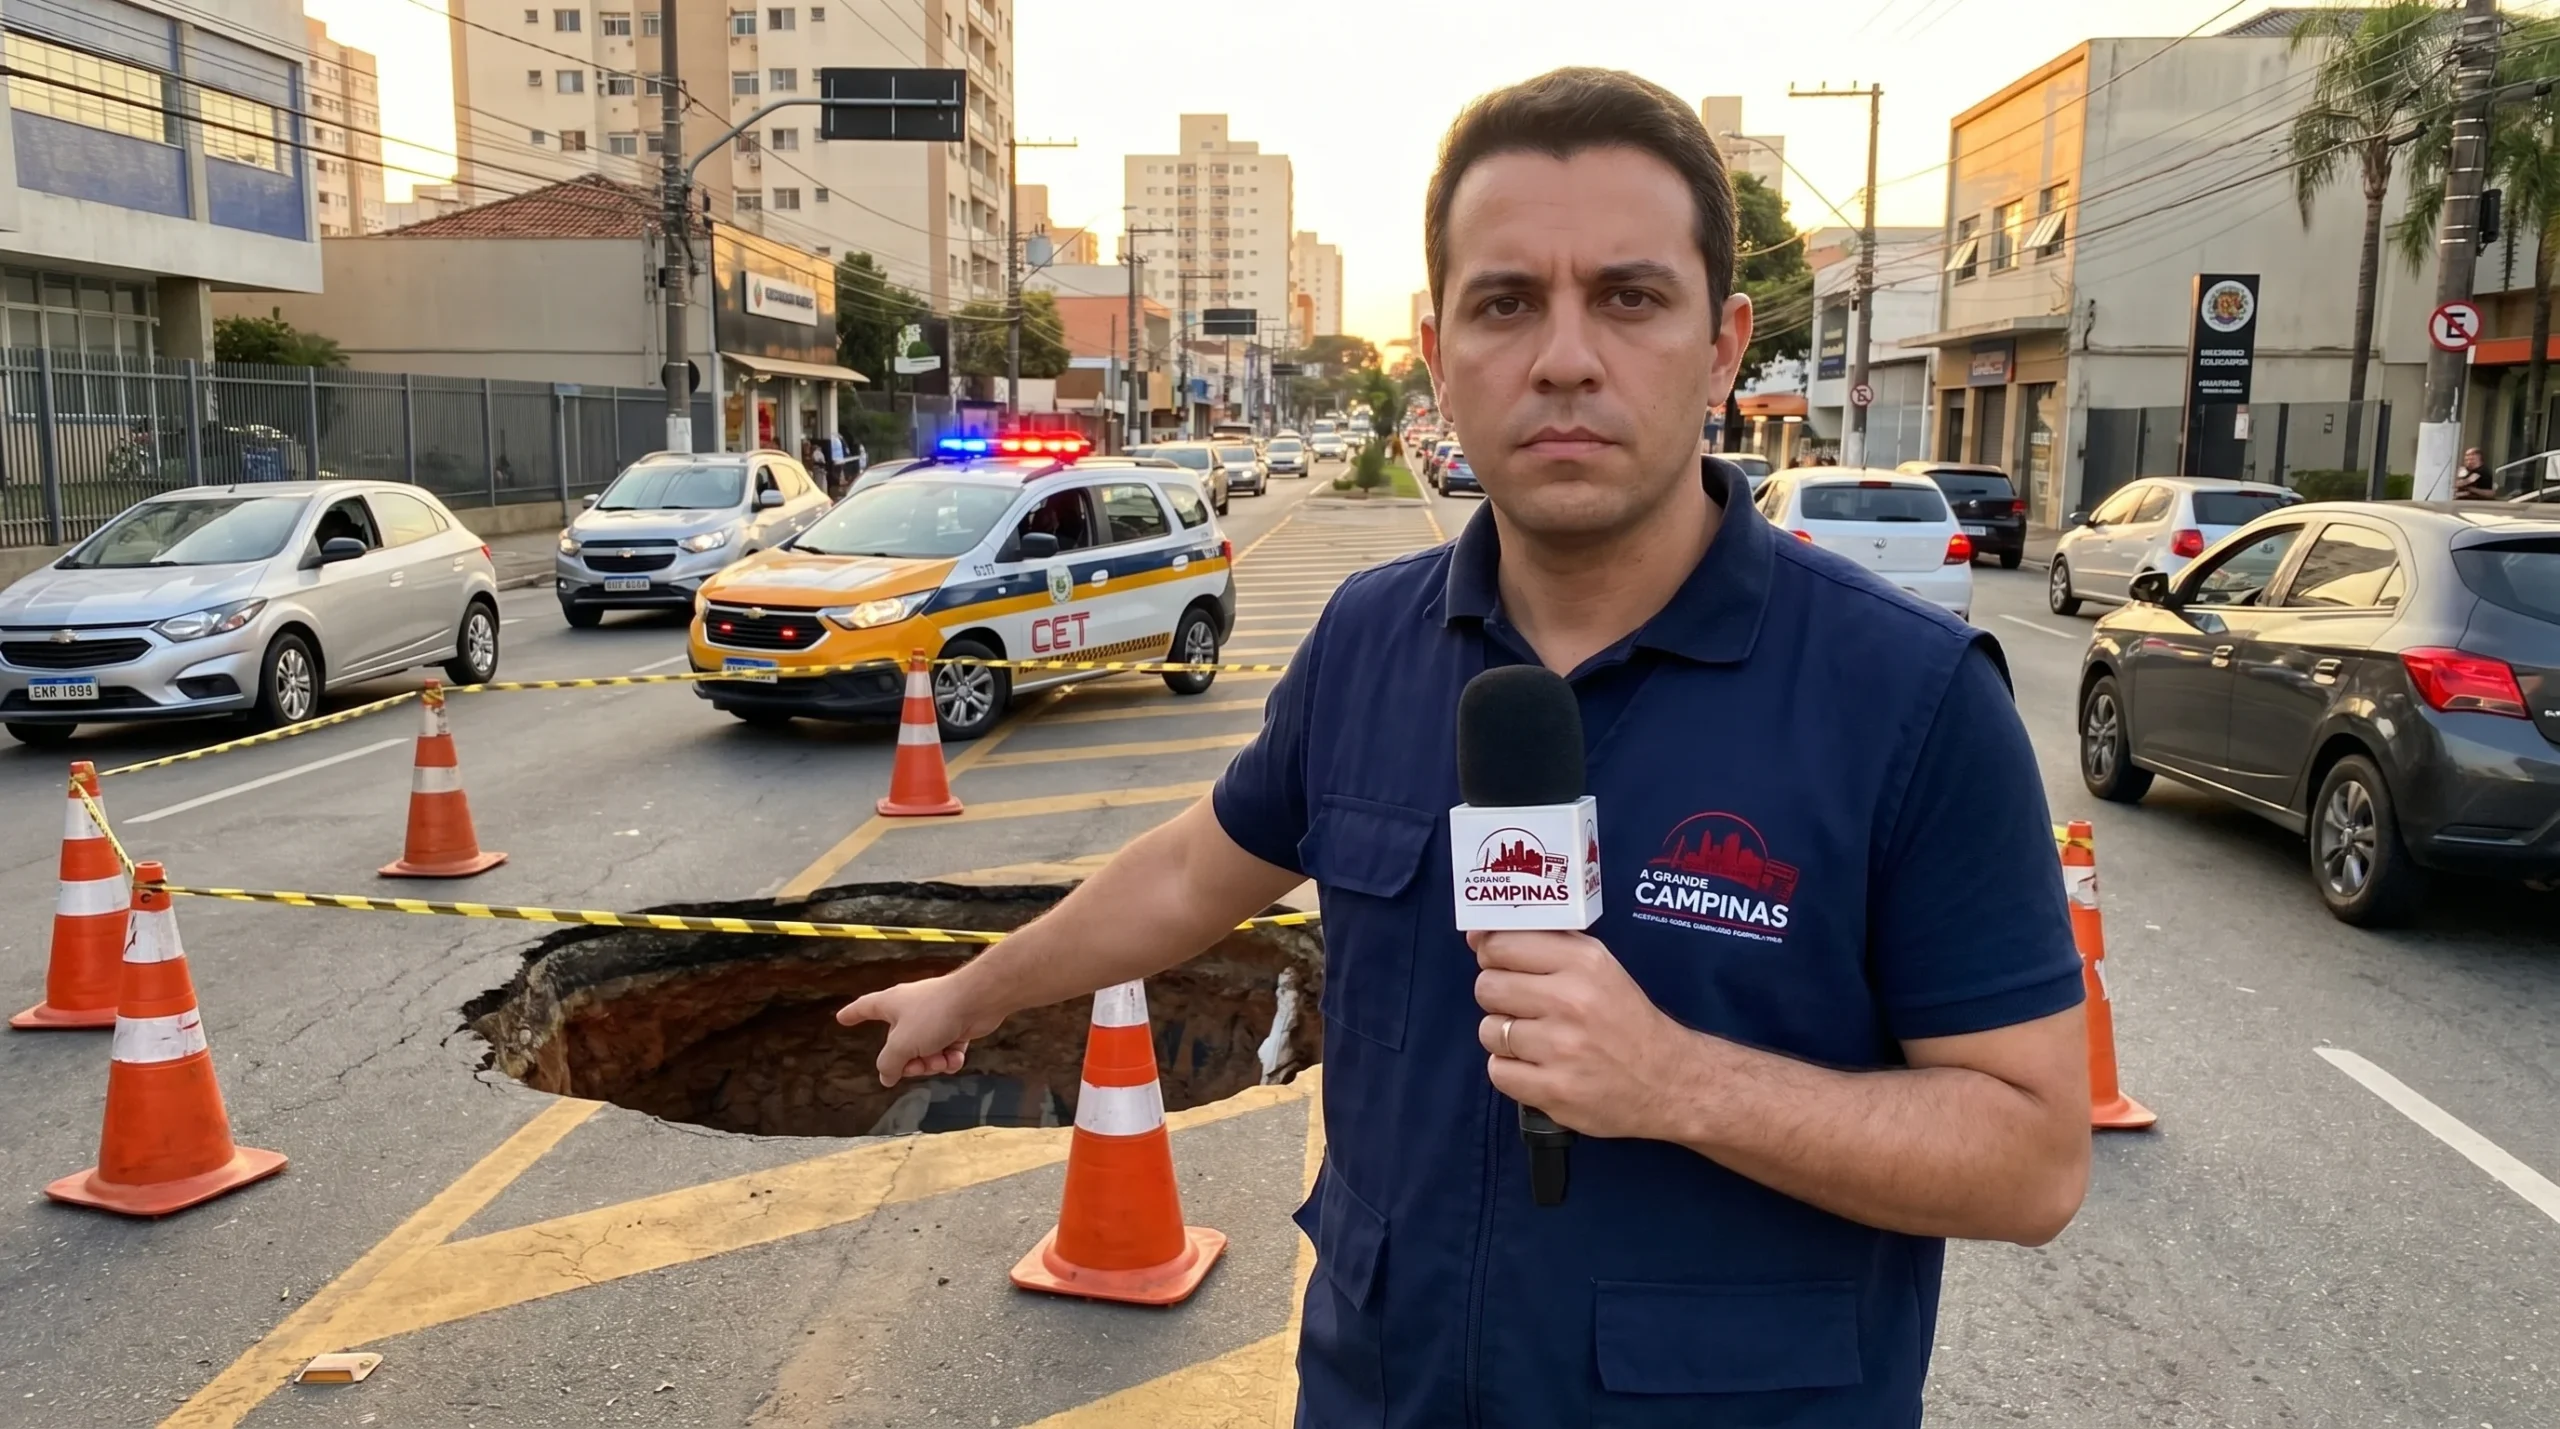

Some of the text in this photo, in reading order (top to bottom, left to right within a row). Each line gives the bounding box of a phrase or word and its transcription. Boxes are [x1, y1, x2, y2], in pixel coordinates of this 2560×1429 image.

[1032, 612, 1090, 653] CET
[1465, 885, 1569, 901] CAMPINAS
[1640, 869, 1709, 889] A GRANDE
[1635, 882, 1789, 928] CAMPINAS
